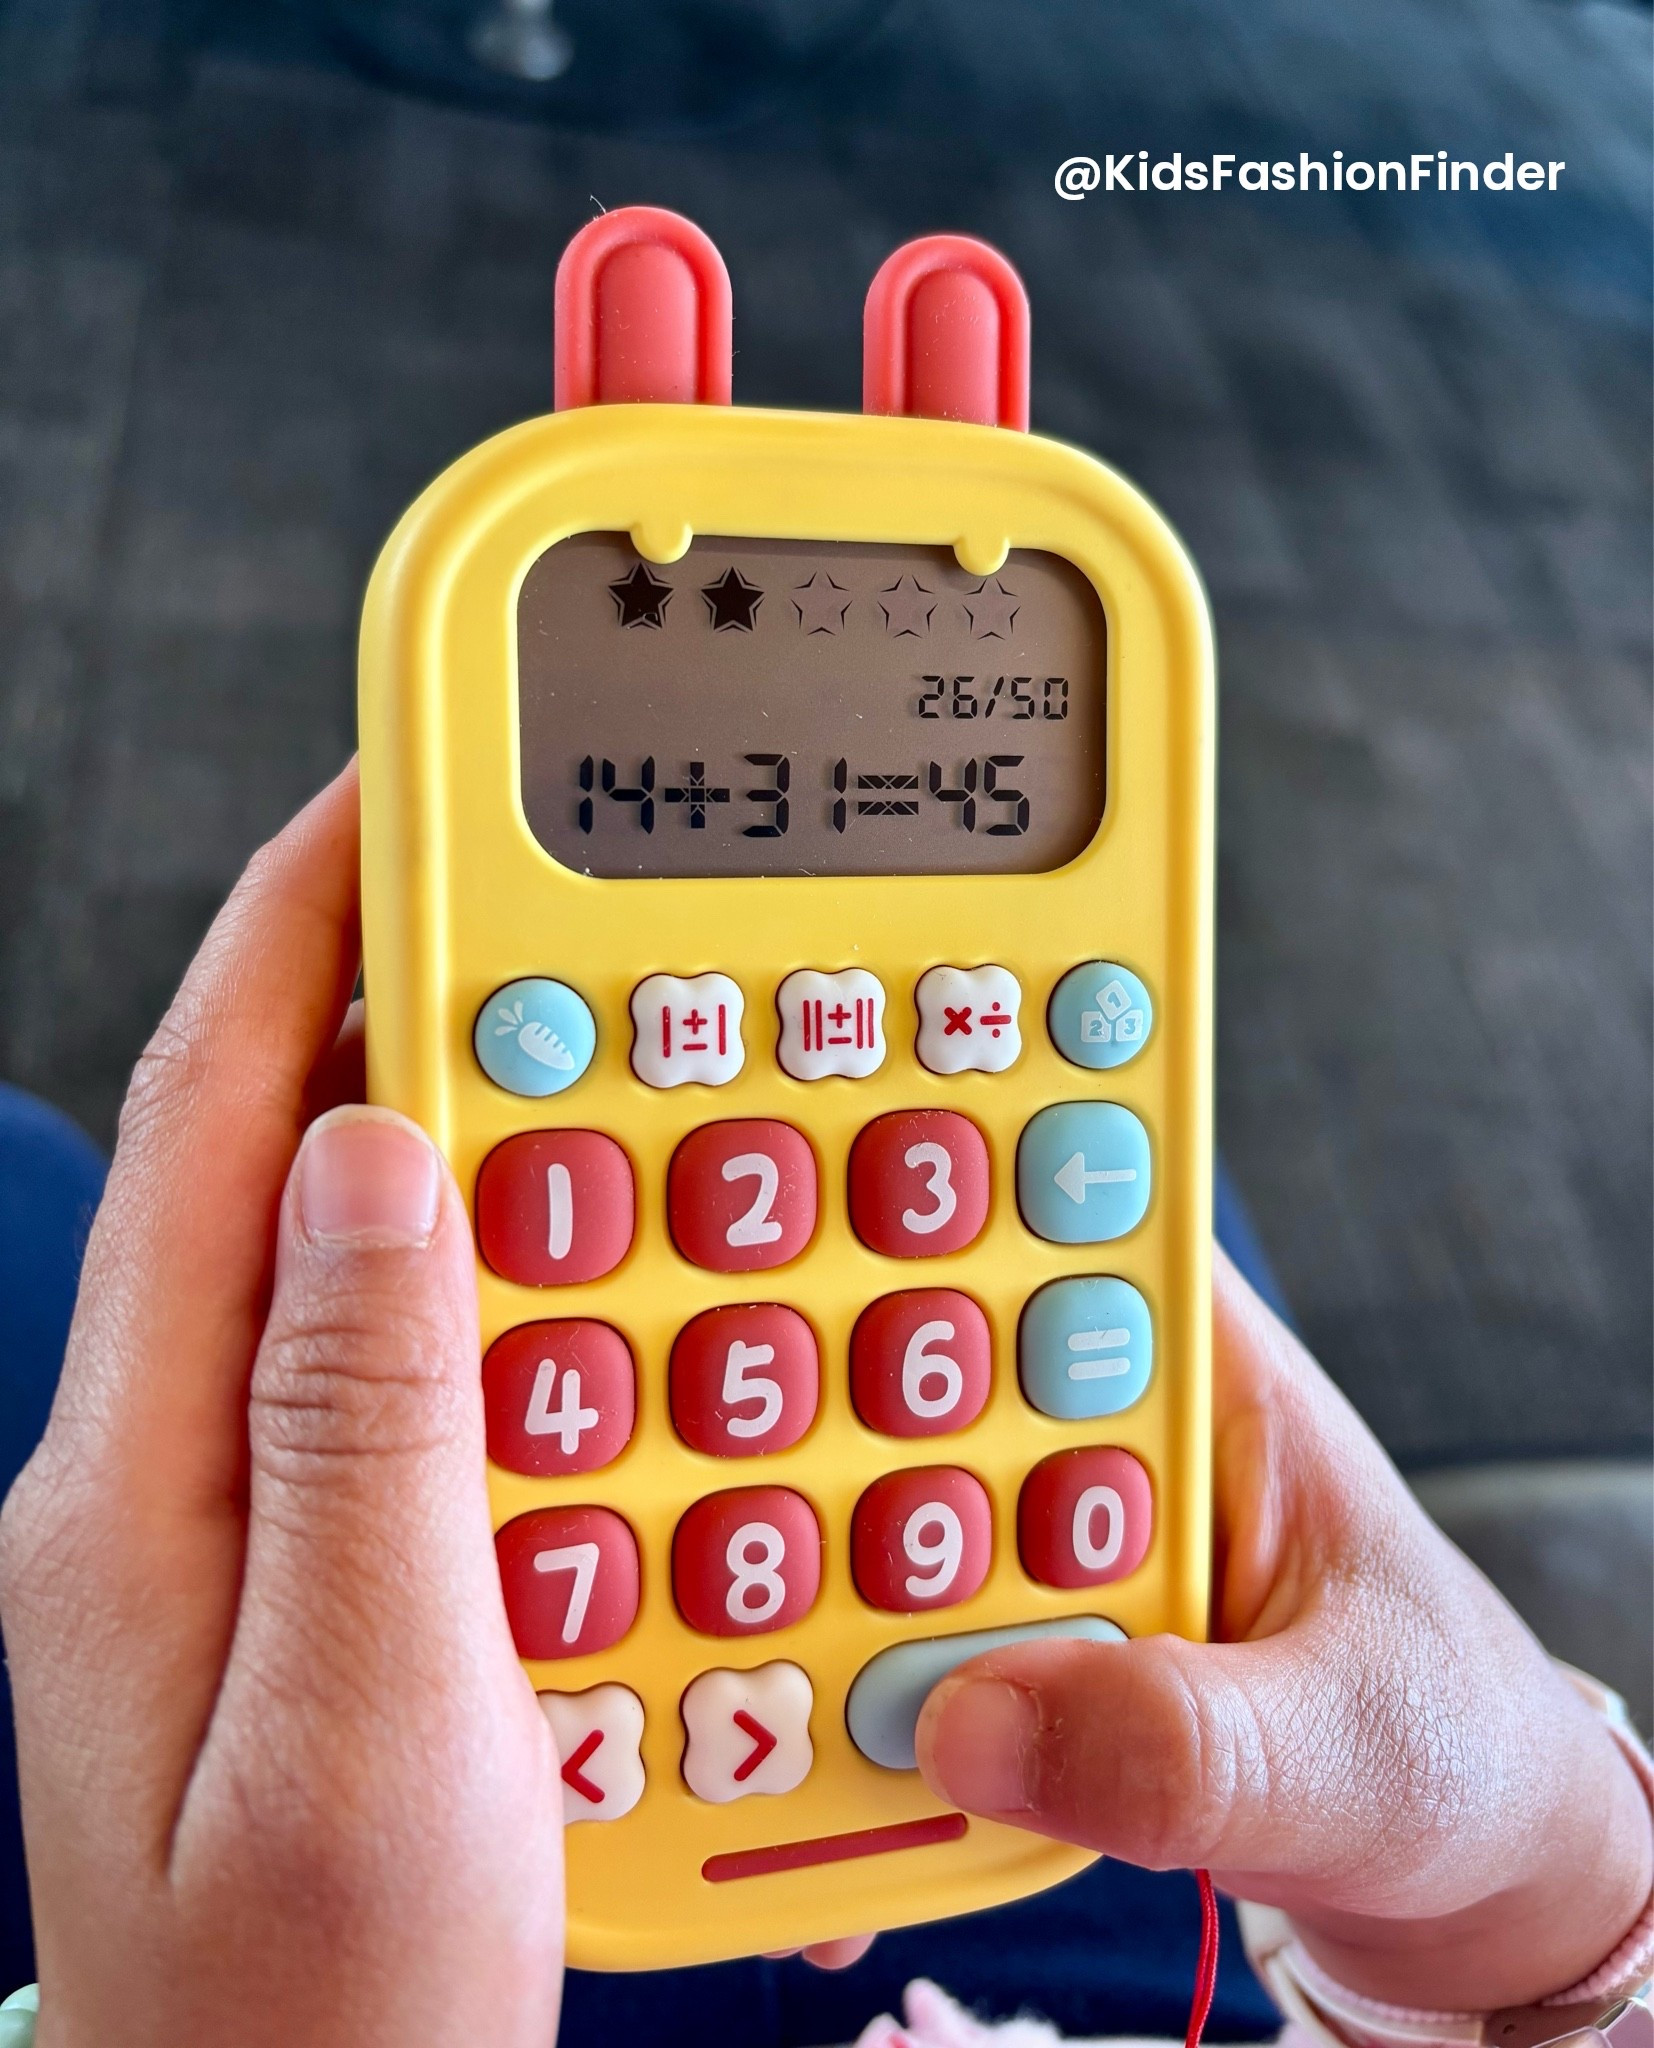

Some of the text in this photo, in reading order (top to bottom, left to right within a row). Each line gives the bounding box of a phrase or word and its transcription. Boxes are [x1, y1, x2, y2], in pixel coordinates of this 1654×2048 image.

[918, 675, 1068, 720] 26/50
[547, 1163, 573, 1260] 1
[721, 1153, 783, 1247] 2
[902, 1142, 957, 1234] 3
[524, 1358, 599, 1455] 4
[722, 1340, 784, 1439] 5
[902, 1320, 964, 1418] 6
[726, 1522, 786, 1624] 8
[903, 1502, 963, 1598] 9
[1072, 1485, 1125, 1569] 0
[534, 1542, 600, 1643] 7
